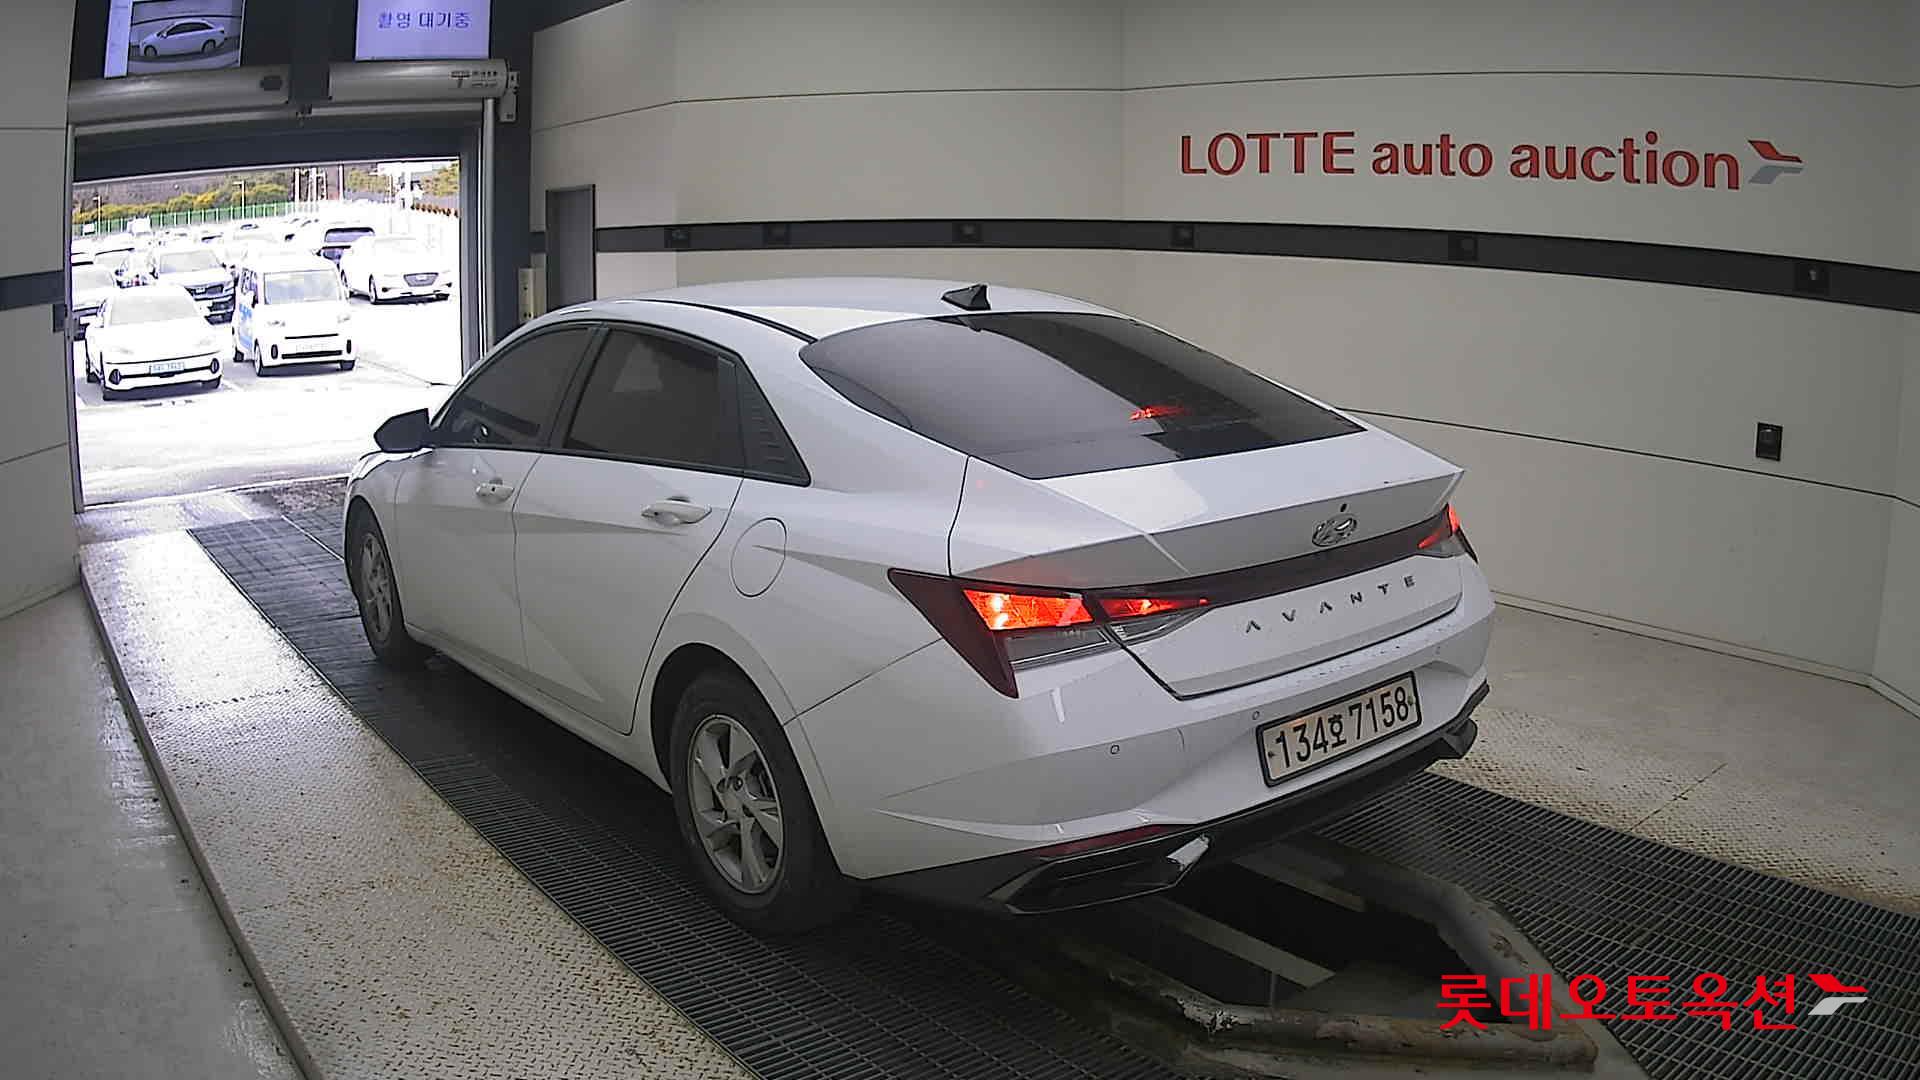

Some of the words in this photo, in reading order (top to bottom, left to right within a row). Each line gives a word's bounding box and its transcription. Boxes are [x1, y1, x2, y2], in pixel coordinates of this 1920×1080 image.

[419, 12, 469, 28] 대기중
[1181, 132, 1356, 175] LOTTE
[1372, 135, 1494, 176] auto
[1510, 132, 1741, 189] auction
[1245, 575, 1416, 633] AVANTE
